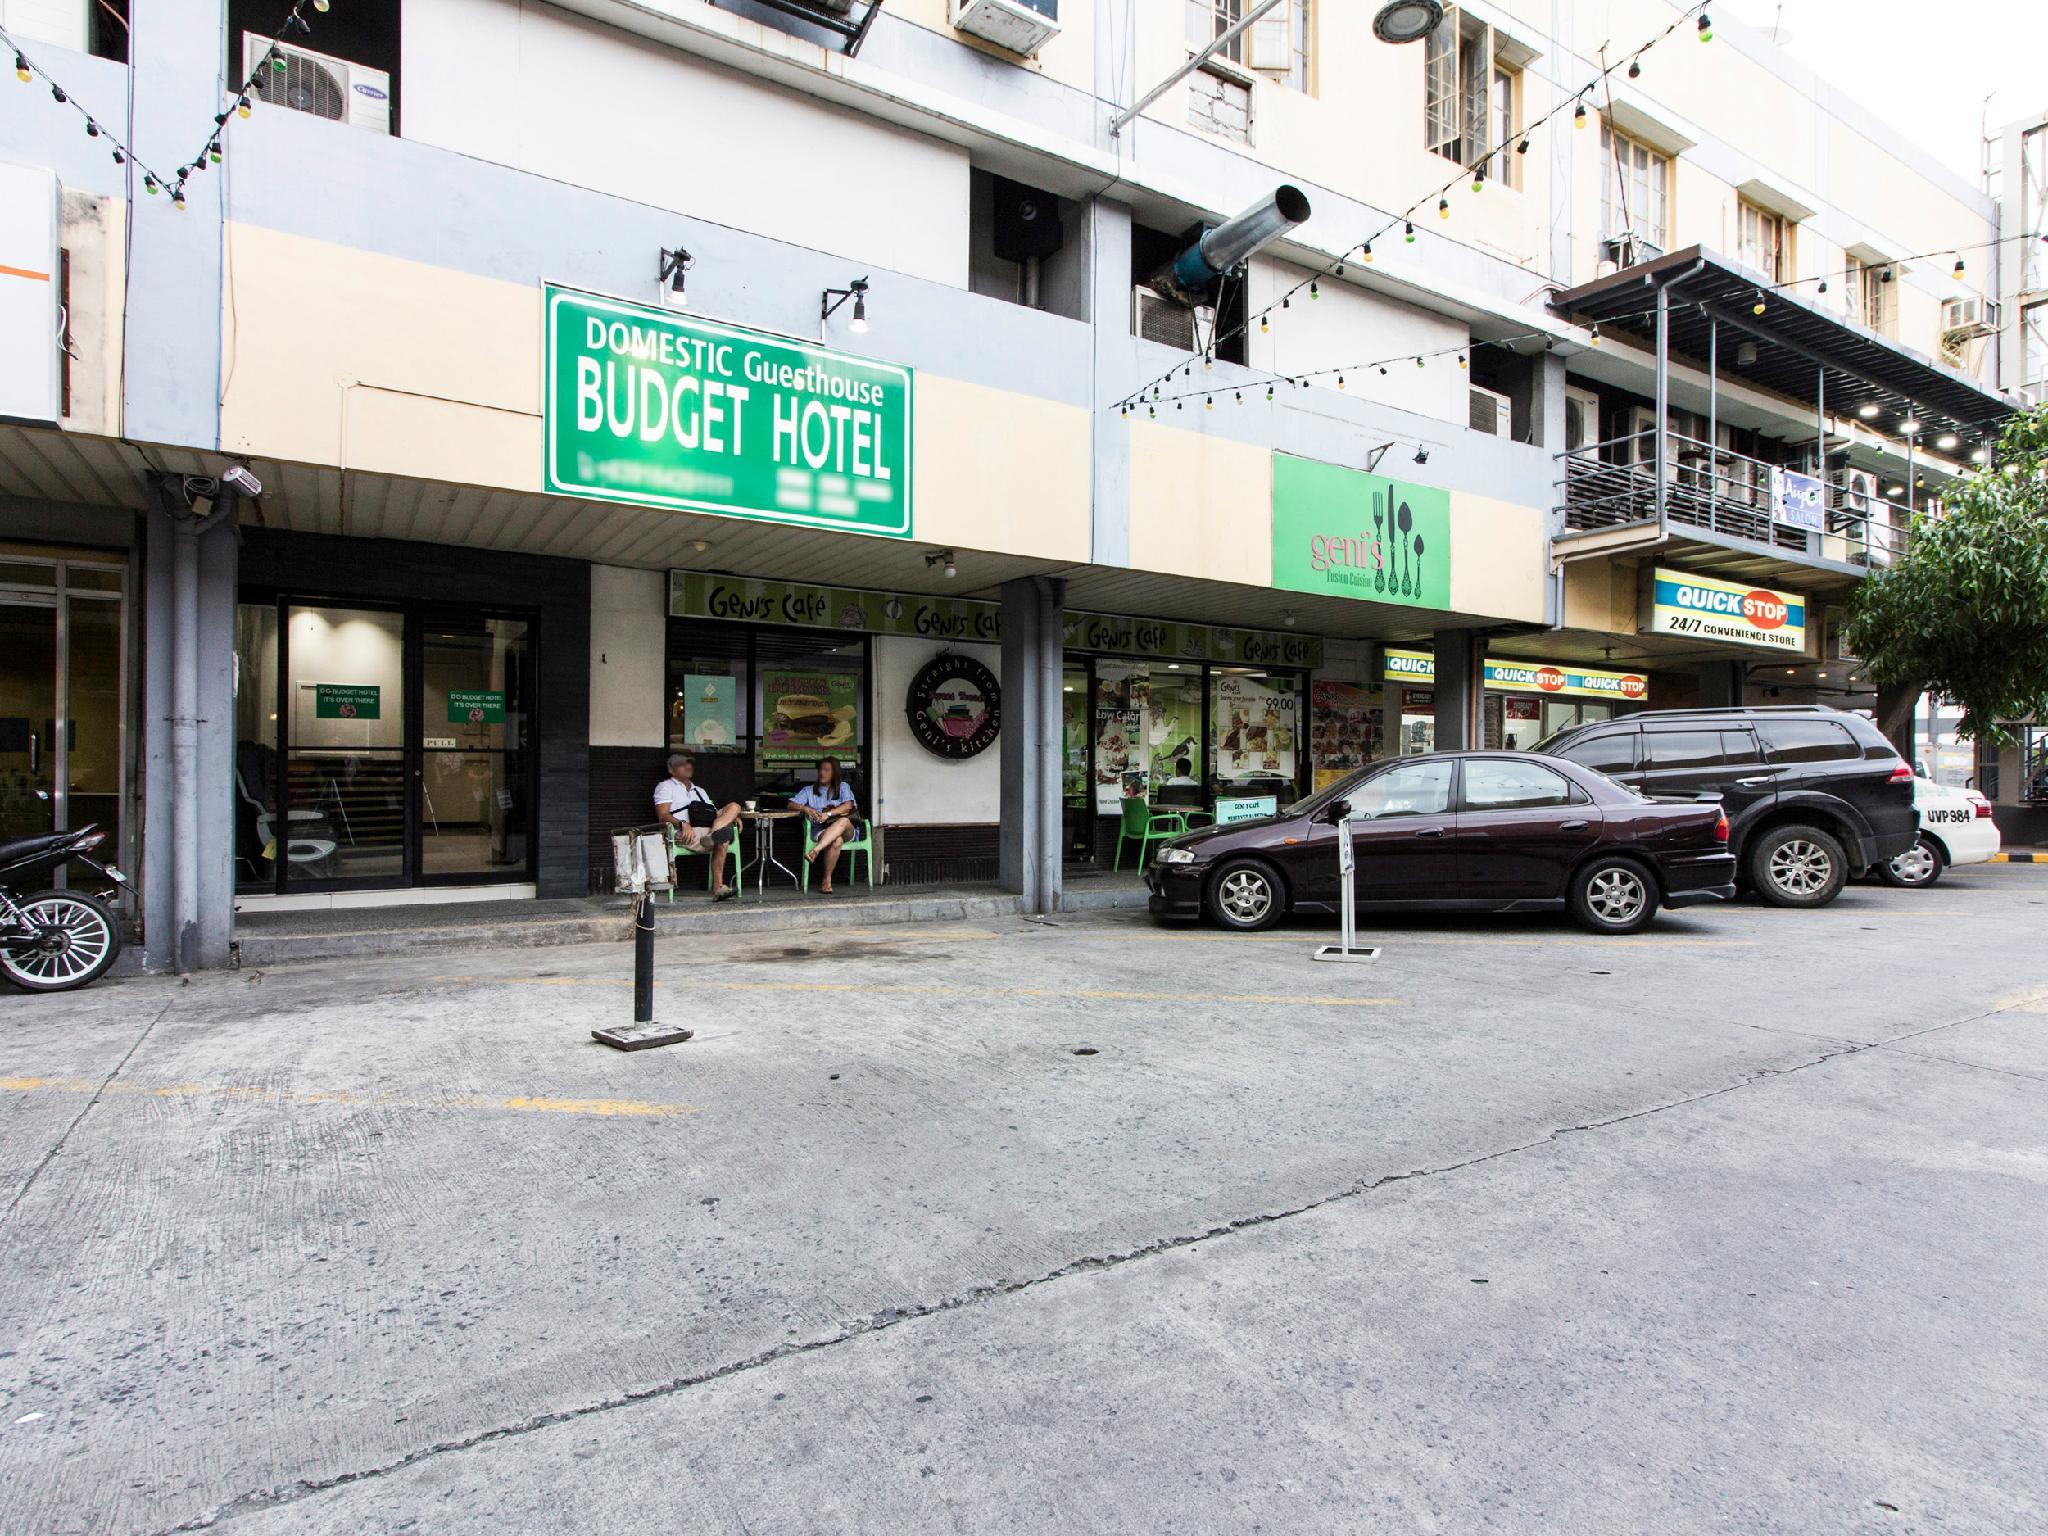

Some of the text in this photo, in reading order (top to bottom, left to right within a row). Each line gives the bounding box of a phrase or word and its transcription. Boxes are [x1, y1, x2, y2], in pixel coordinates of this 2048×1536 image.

[586, 316, 884, 407] DOMESTIC Guesthouse
[577, 355, 750, 456] BUDGET
[772, 392, 891, 480] HOTEL
[1311, 531, 1384, 571] geni's
[1327, 569, 1373, 587] Fusion Cuisine
[1677, 586, 1787, 620] QUICK STOP
[974, 611, 1001, 638] Caf
[1669, 616, 1796, 646] 24/7 CONVENIENCE STORE
[976, 668, 999, 702] from
[1494, 667, 1565, 686] QUICK STOP
[1584, 676, 1645, 692] QUICK STOP
[332, 688, 357, 697] BUDGET
[358, 689, 379, 697] HOTEL
[335, 696, 354, 704] OVER
[465, 701, 481, 709] OVER
[1265, 697, 1294, 711] 99.00
[1096, 709, 1115, 719] Low
[1927, 809, 1970, 823] UVP 984
